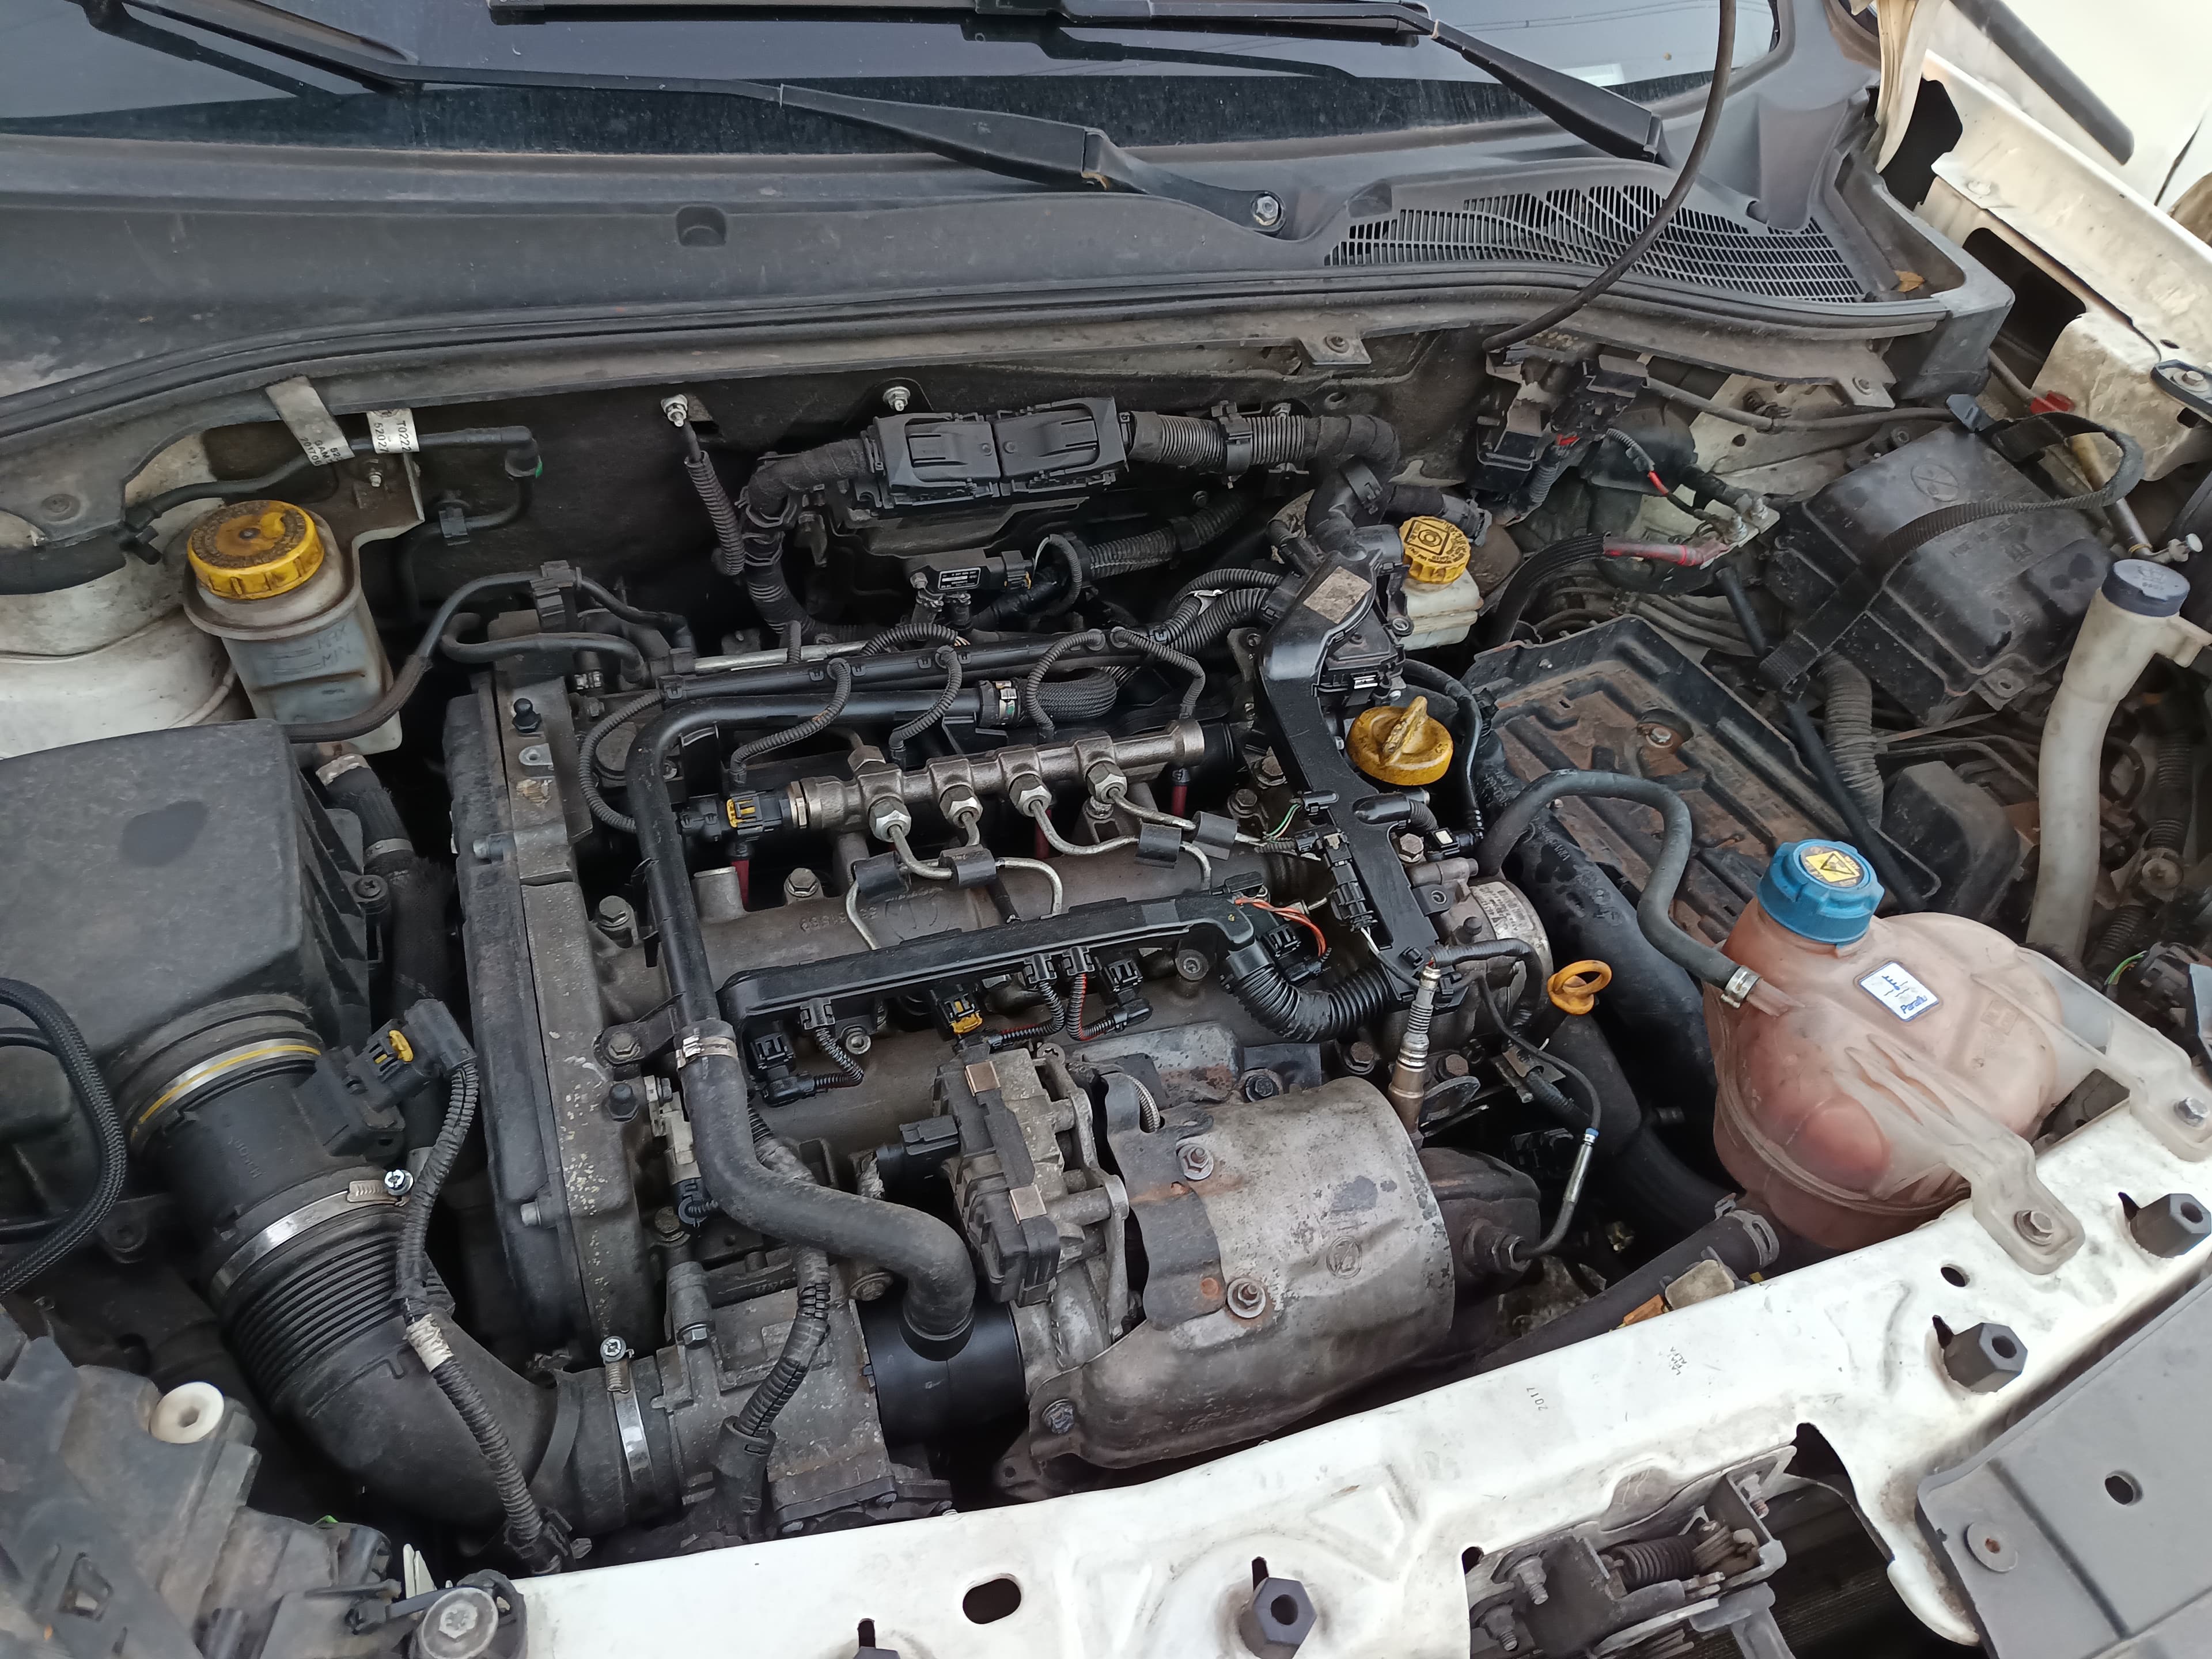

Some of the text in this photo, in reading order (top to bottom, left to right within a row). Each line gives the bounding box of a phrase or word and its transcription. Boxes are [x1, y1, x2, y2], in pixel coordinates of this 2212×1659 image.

[396, 421, 411, 452] T0222
[321, 642, 351, 667] MIN
[1527, 1387, 1549, 1411] 2017
